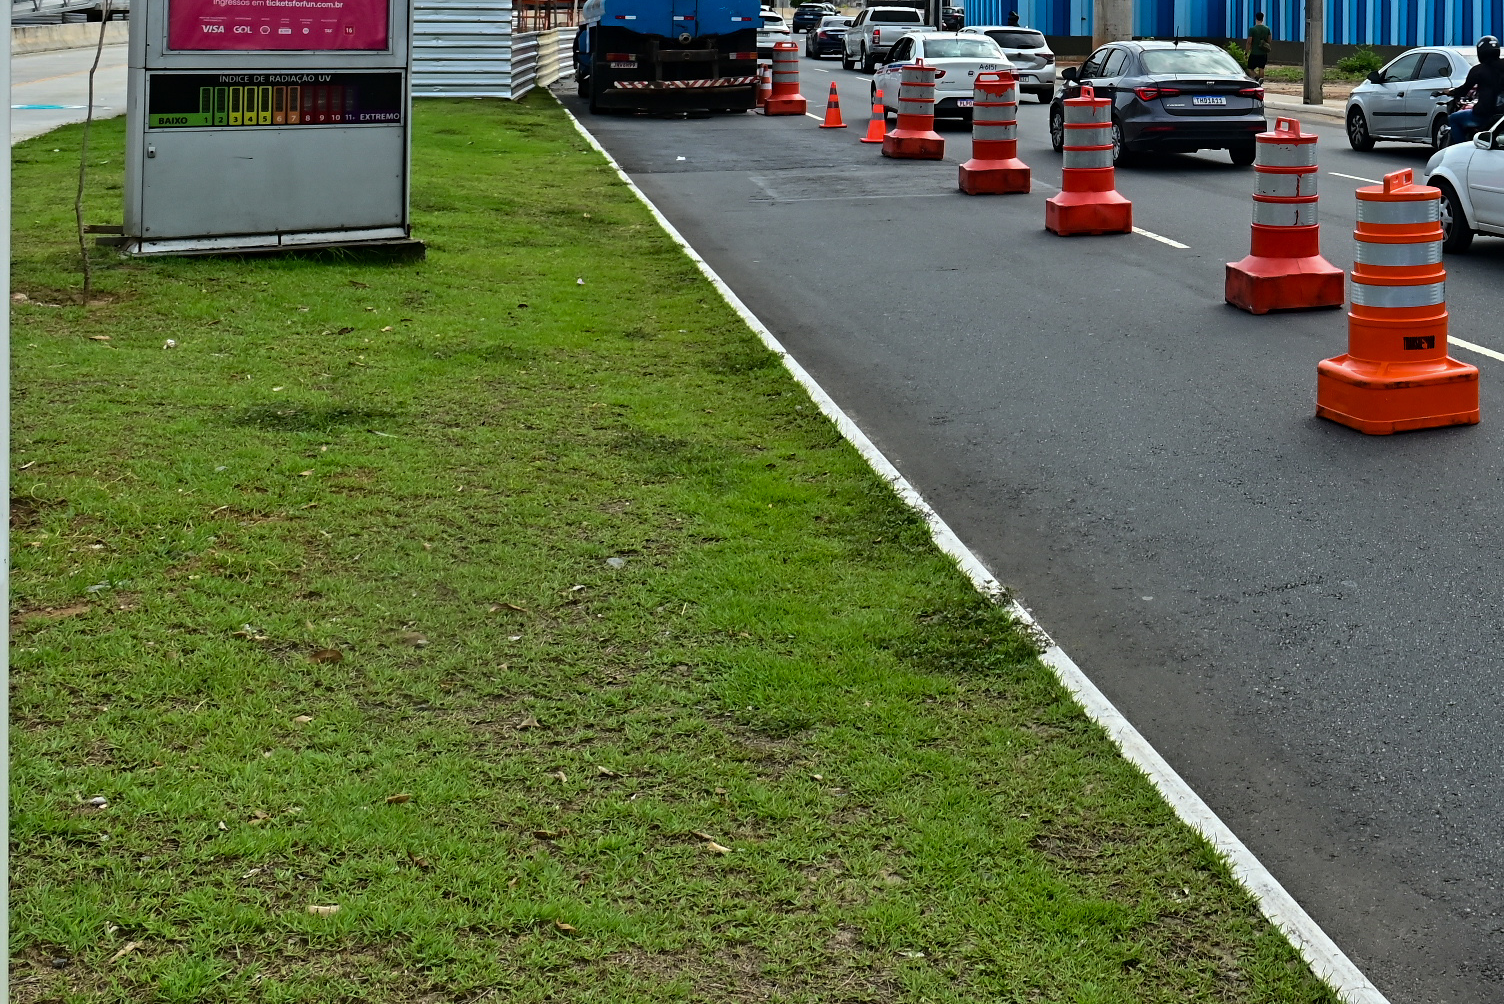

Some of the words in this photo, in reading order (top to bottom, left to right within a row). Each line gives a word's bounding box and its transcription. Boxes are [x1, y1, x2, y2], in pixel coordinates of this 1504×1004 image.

[201, 25, 225, 33] VISA
[233, 25, 252, 34] GOL
[219, 74, 250, 83] ÍNDICE
[253, 75, 266, 83] DE
[269, 74, 315, 84] RADIAÇÃO
[158, 116, 188, 125] BAIXO
[360, 112, 400, 121] EXTREMO
